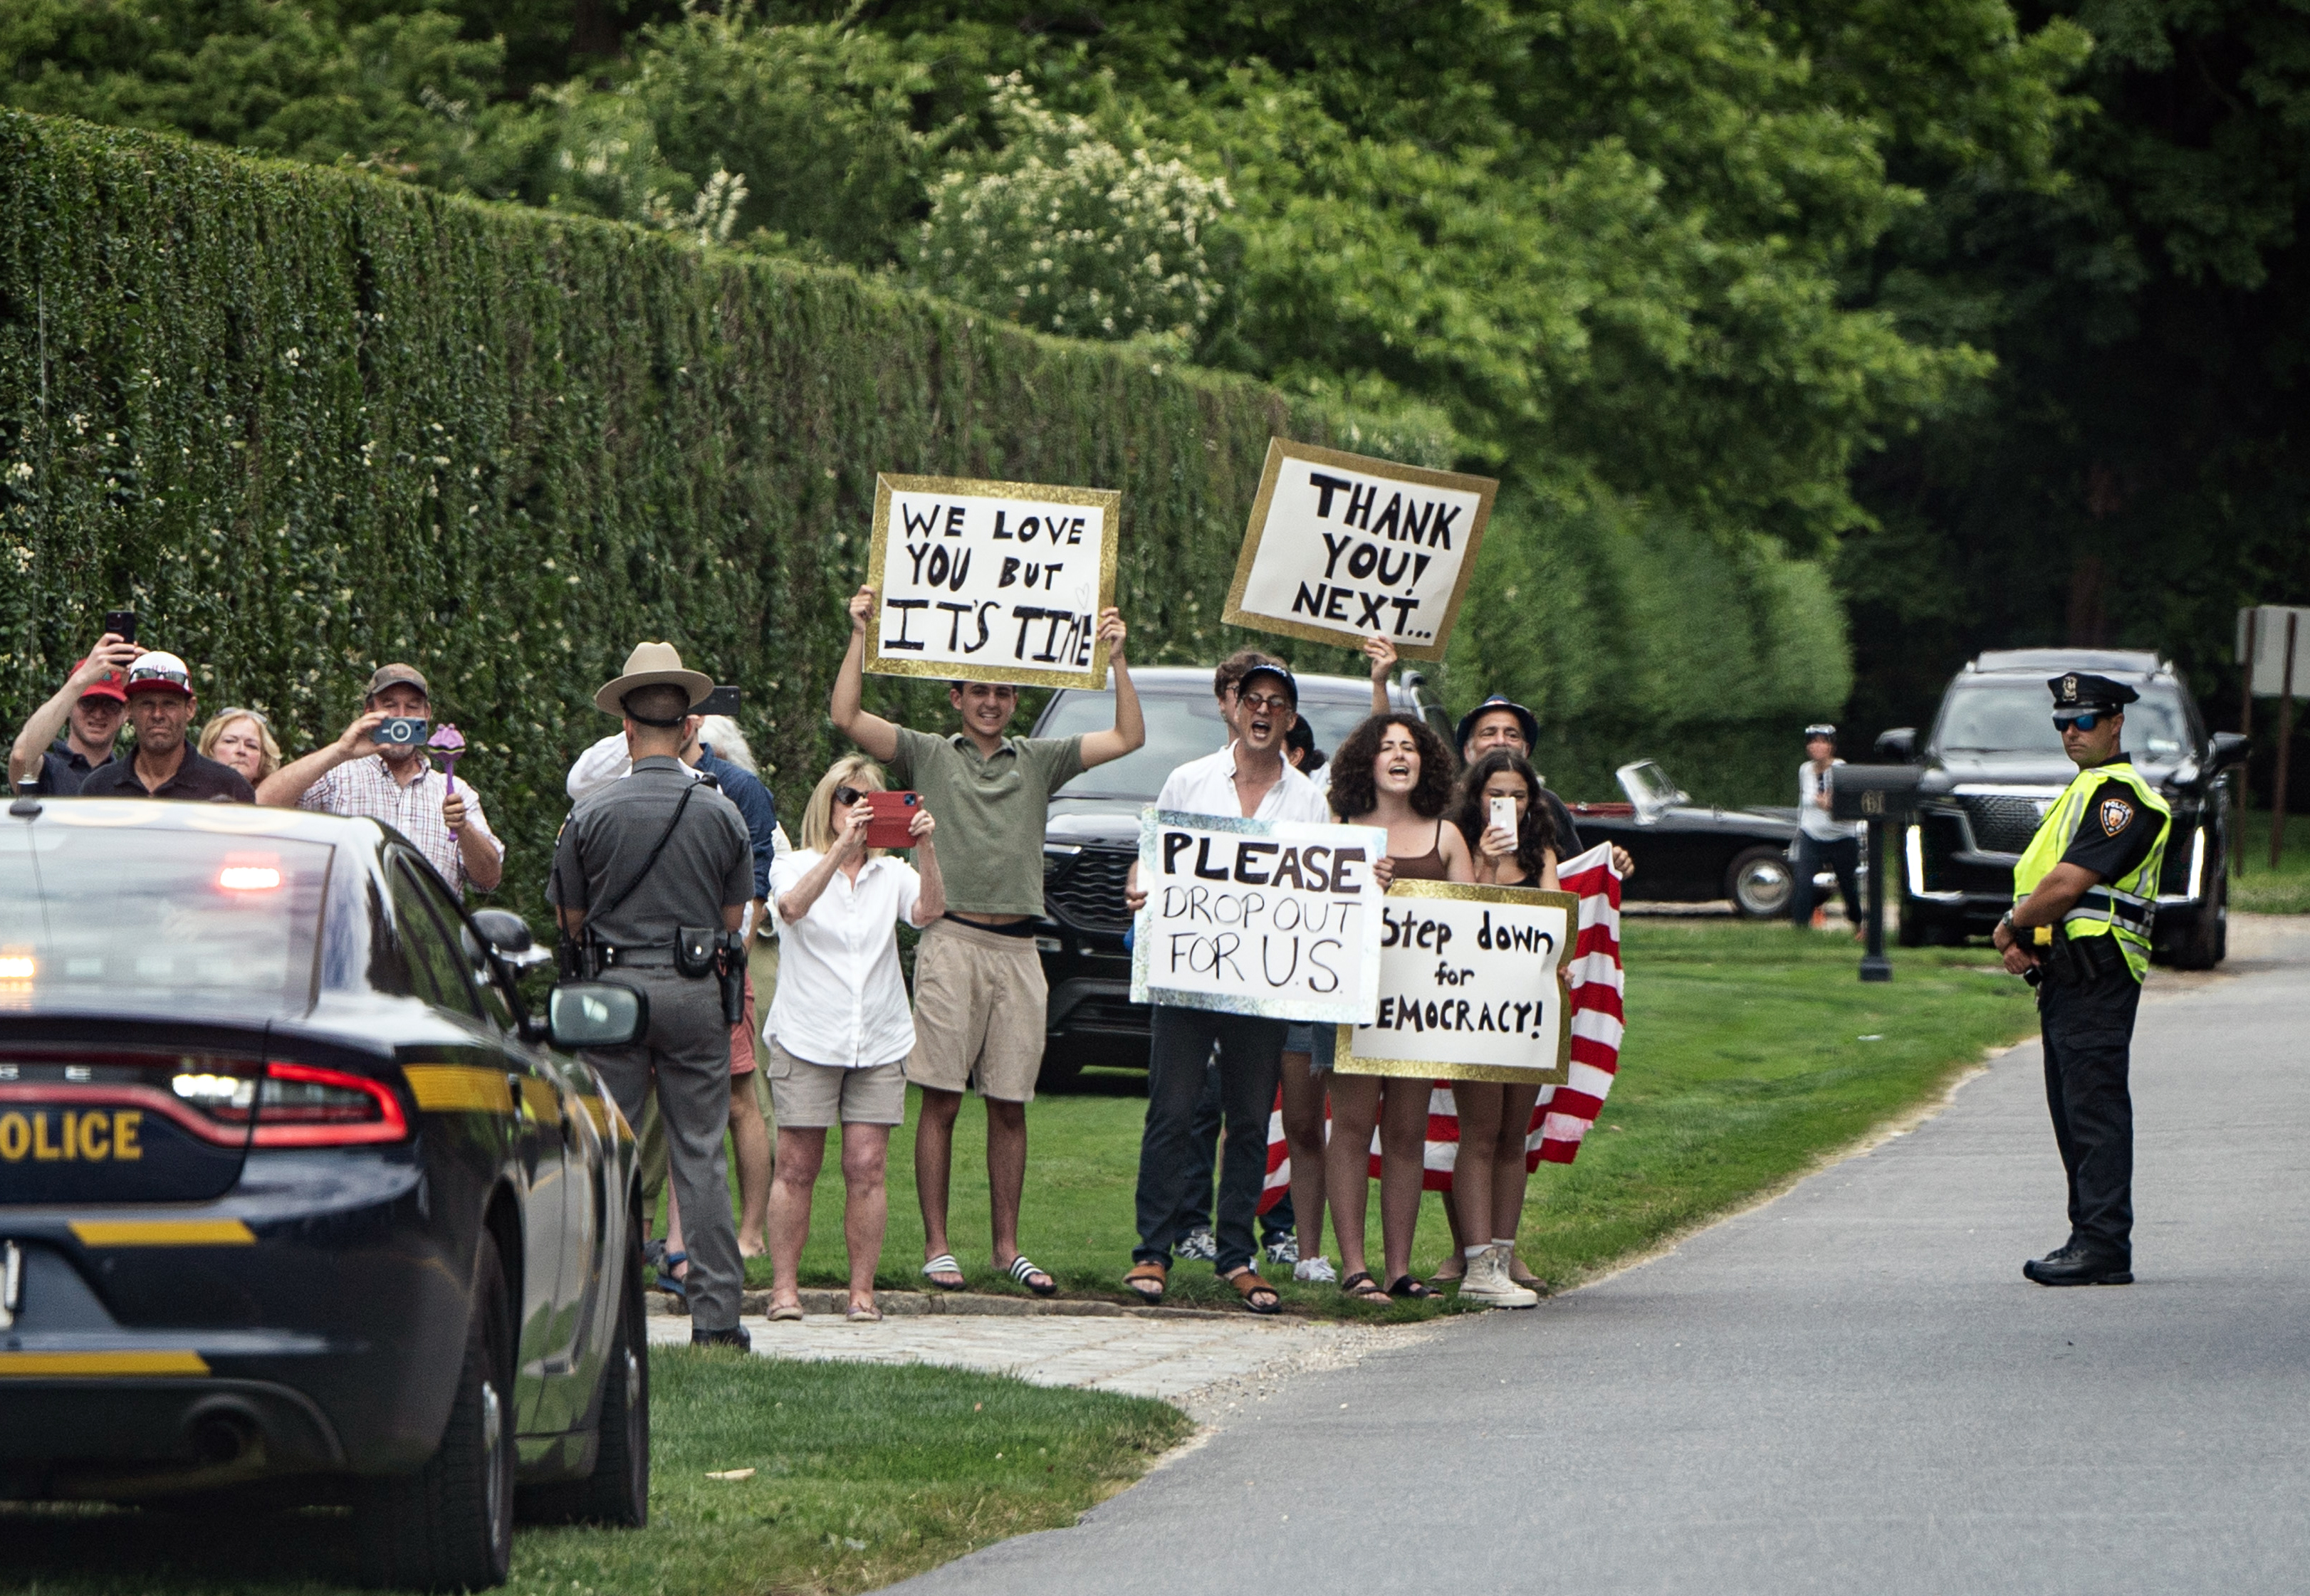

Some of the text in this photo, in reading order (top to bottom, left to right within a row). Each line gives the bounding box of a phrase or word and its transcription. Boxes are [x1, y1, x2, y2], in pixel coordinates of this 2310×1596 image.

[902, 502, 1086, 546] WE LOVE
[1309, 472, 1462, 550] THANK
[906, 542, 1064, 592] YOU BUT
[1322, 532, 1431, 596] YOU!
[884, 599, 1092, 666] IT'S TIME
[1291, 580, 1431, 639] NEXT...
[1164, 831, 1366, 893] PLEASE
[1162, 885, 1362, 934] DROP OUT
[1381, 906, 1554, 955] Step down
[1168, 931, 1344, 993] FOR U.S.
[1433, 960, 1475, 987] for
[1359, 993, 1543, 1040] EMOCRACY!
